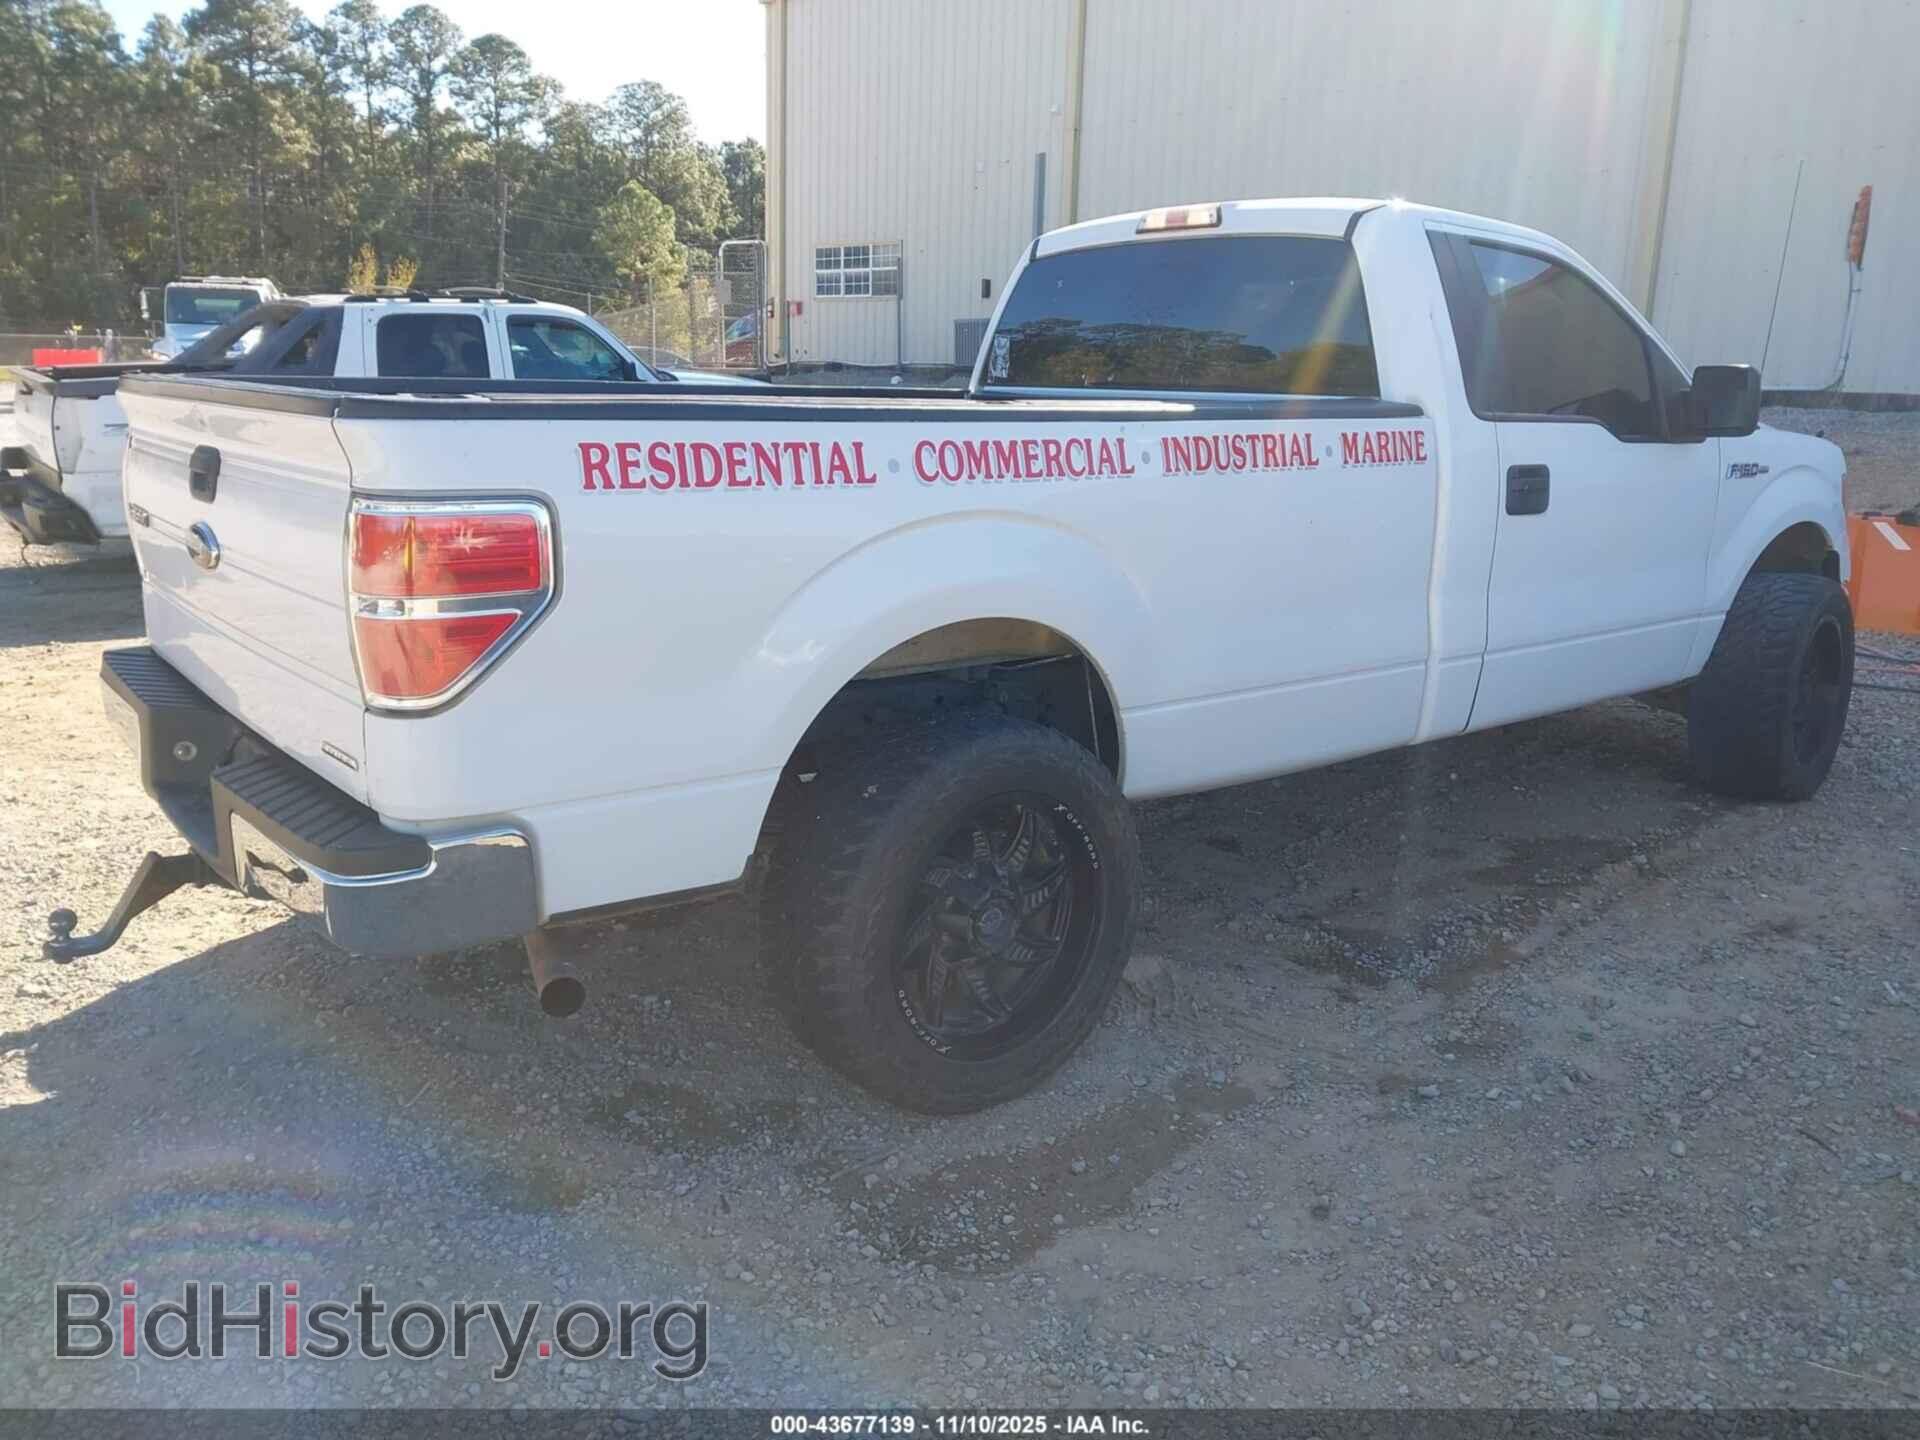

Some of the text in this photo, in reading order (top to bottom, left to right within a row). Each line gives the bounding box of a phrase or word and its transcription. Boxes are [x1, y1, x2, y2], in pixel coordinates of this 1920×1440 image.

[577, 430, 1428, 491] RESIDENTIAL COMMERCIAL INDUSTRIAL MARINE
